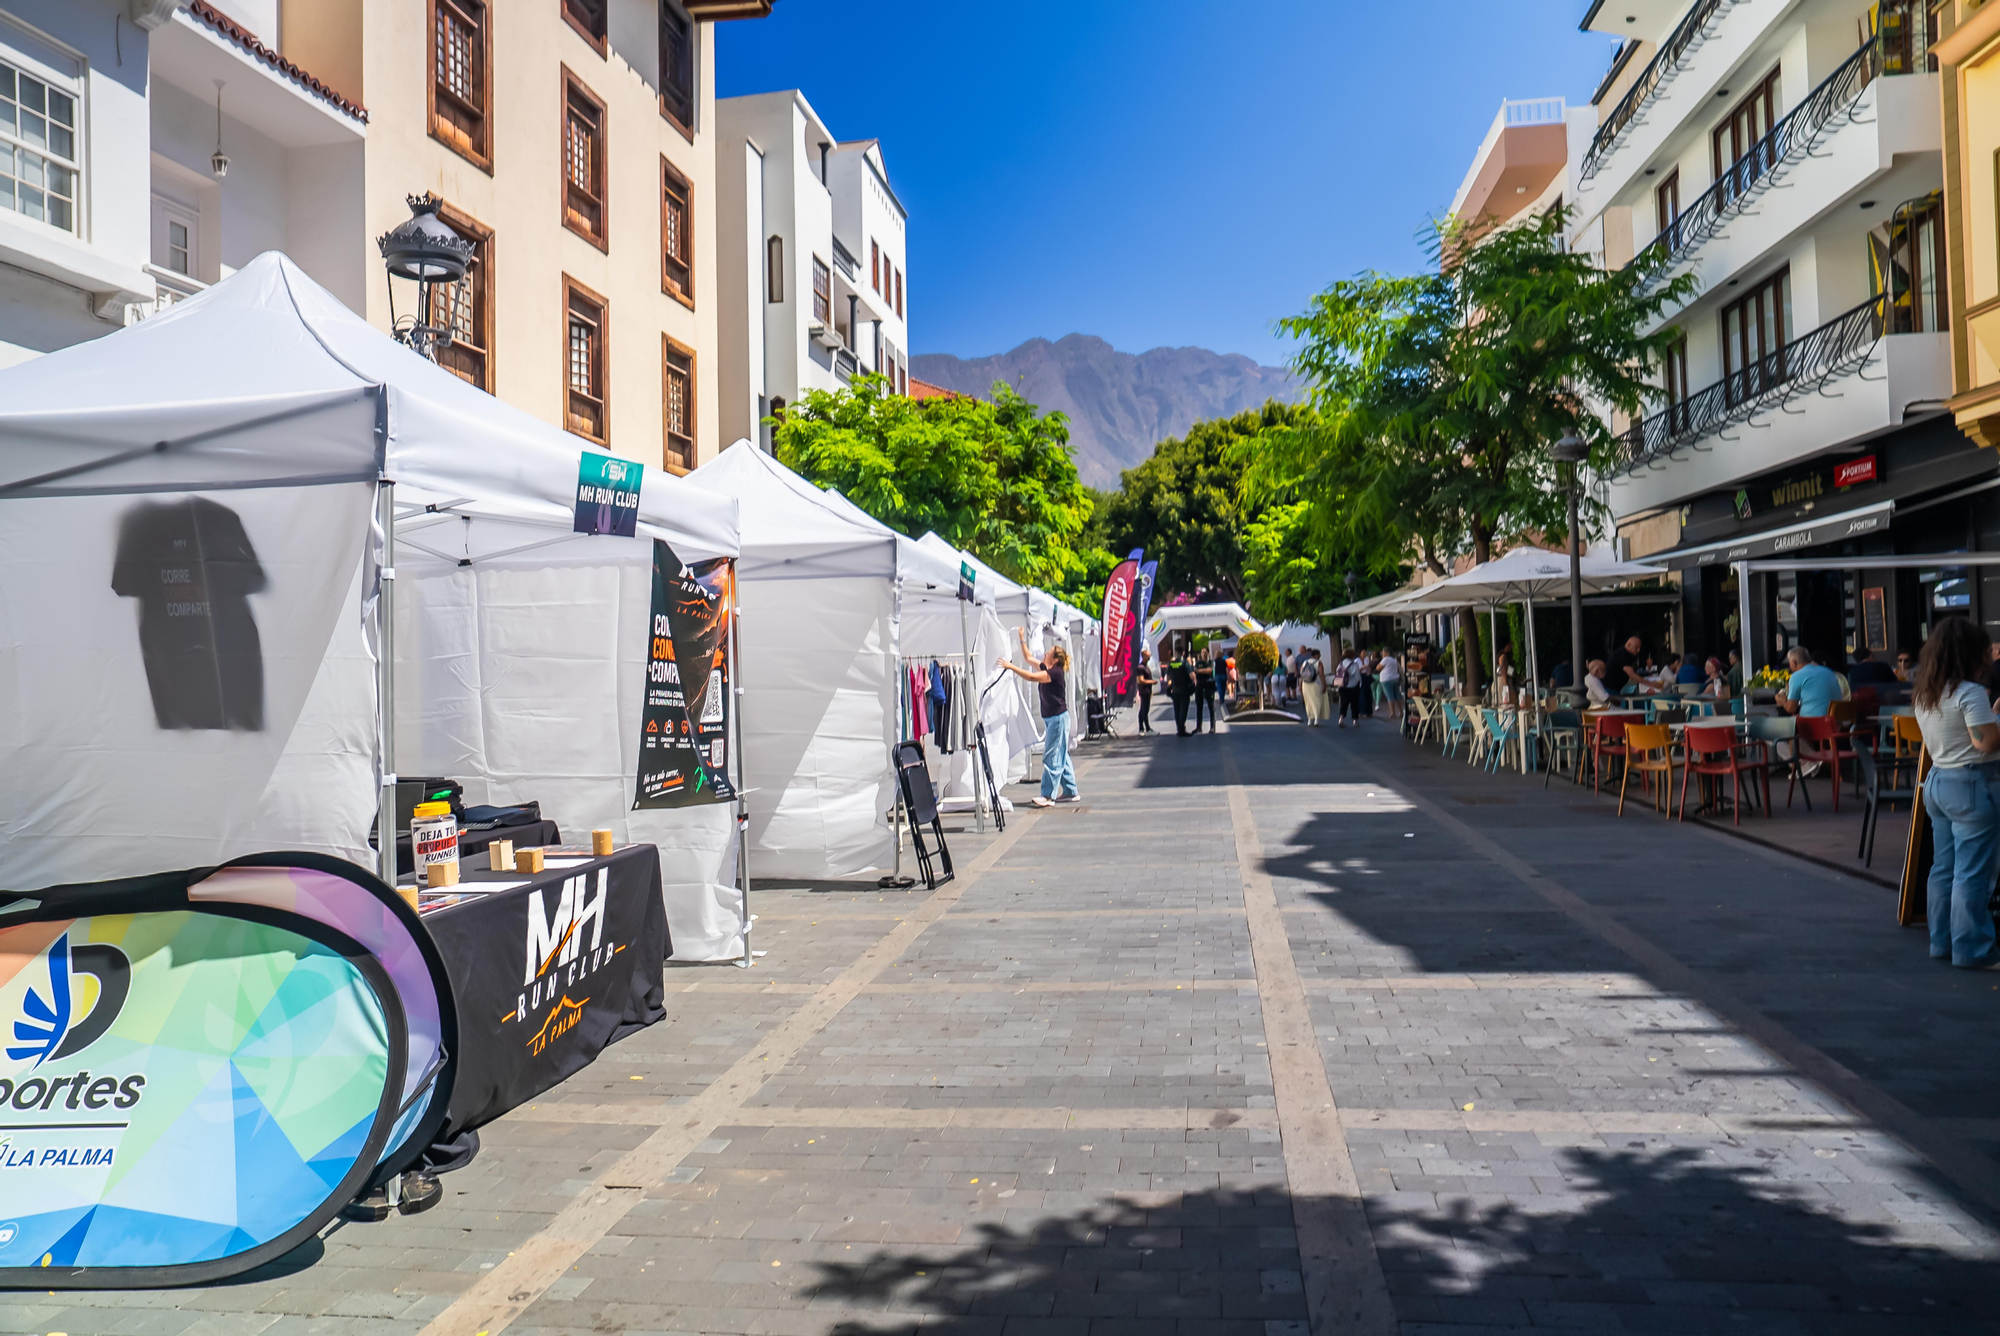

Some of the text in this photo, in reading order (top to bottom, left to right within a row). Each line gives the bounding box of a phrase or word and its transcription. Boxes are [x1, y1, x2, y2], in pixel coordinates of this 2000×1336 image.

[1839, 461, 1872, 483] SPORTIUM
[579, 485, 638, 509] MH RUN CLUB
[1772, 472, 1823, 507] winnit
[1846, 518, 1877, 535] SPORTIUM
[1774, 531, 1812, 551] CARAMBOLA
[161, 569, 191, 583] CORRE
[681, 582, 701, 595] RUN
[167, 602, 212, 617] COMPARTE
[676, 606, 688, 614] LA
[420, 826, 455, 842] DEJA TU
[425, 847, 457, 863] RUNNER
[524, 867, 609, 987] MH
[517, 942, 615, 1023] RUN CLUB
[532, 1007, 582, 1057] LA PALMA
[5, 1148, 114, 1167] LA PALMA
